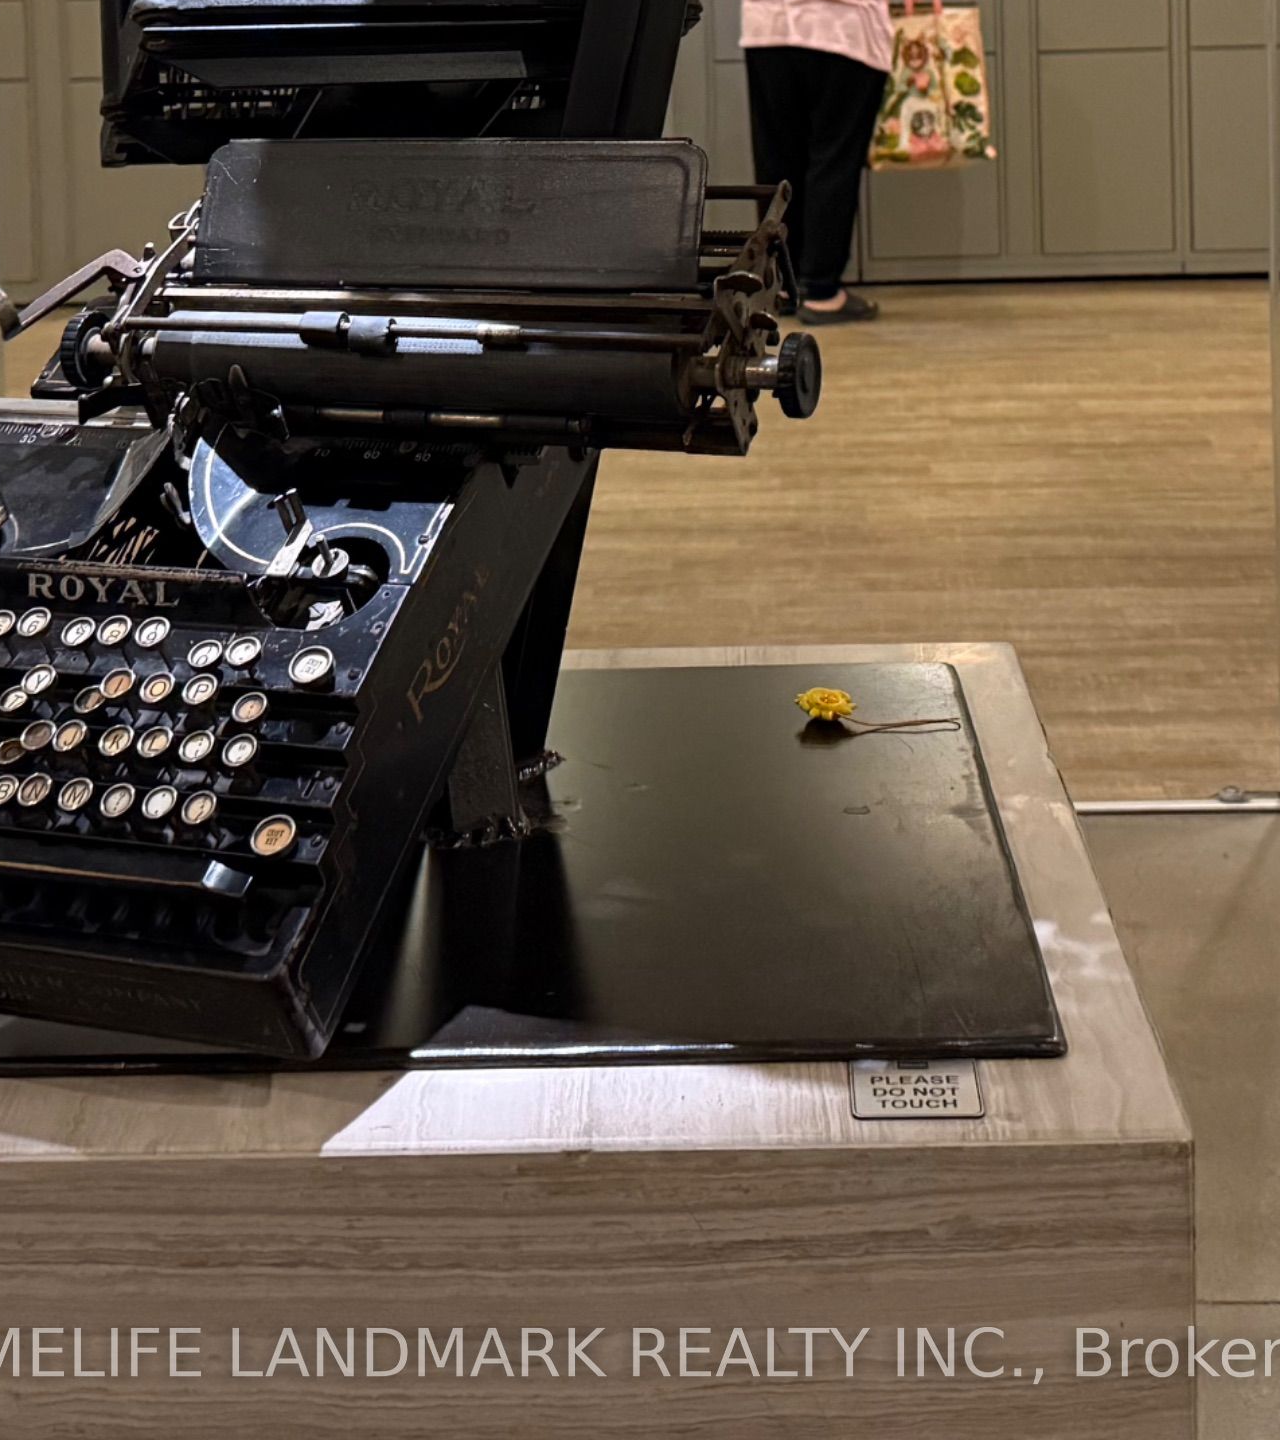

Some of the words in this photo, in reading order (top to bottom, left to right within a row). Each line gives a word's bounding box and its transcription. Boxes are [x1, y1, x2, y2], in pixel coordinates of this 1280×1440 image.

[27, 573, 180, 607] ROYAL
[28, 621, 40, 634] 6
[8, 694, 24, 708] T
[34, 673, 50, 691] Y
[149, 681, 167, 698] O
[192, 683, 210, 698] P
[63, 728, 80, 747] J
[108, 733, 125, 750] K
[147, 734, 162, 752] L
[26, 782, 47, 800] N
[65, 786, 87, 805] M
[870, 1074, 960, 1086] PLEASE
[872, 1086, 905, 1098] DO
[912, 1086, 960, 1098] NOT
[880, 1098, 959, 1110] TOUCH
